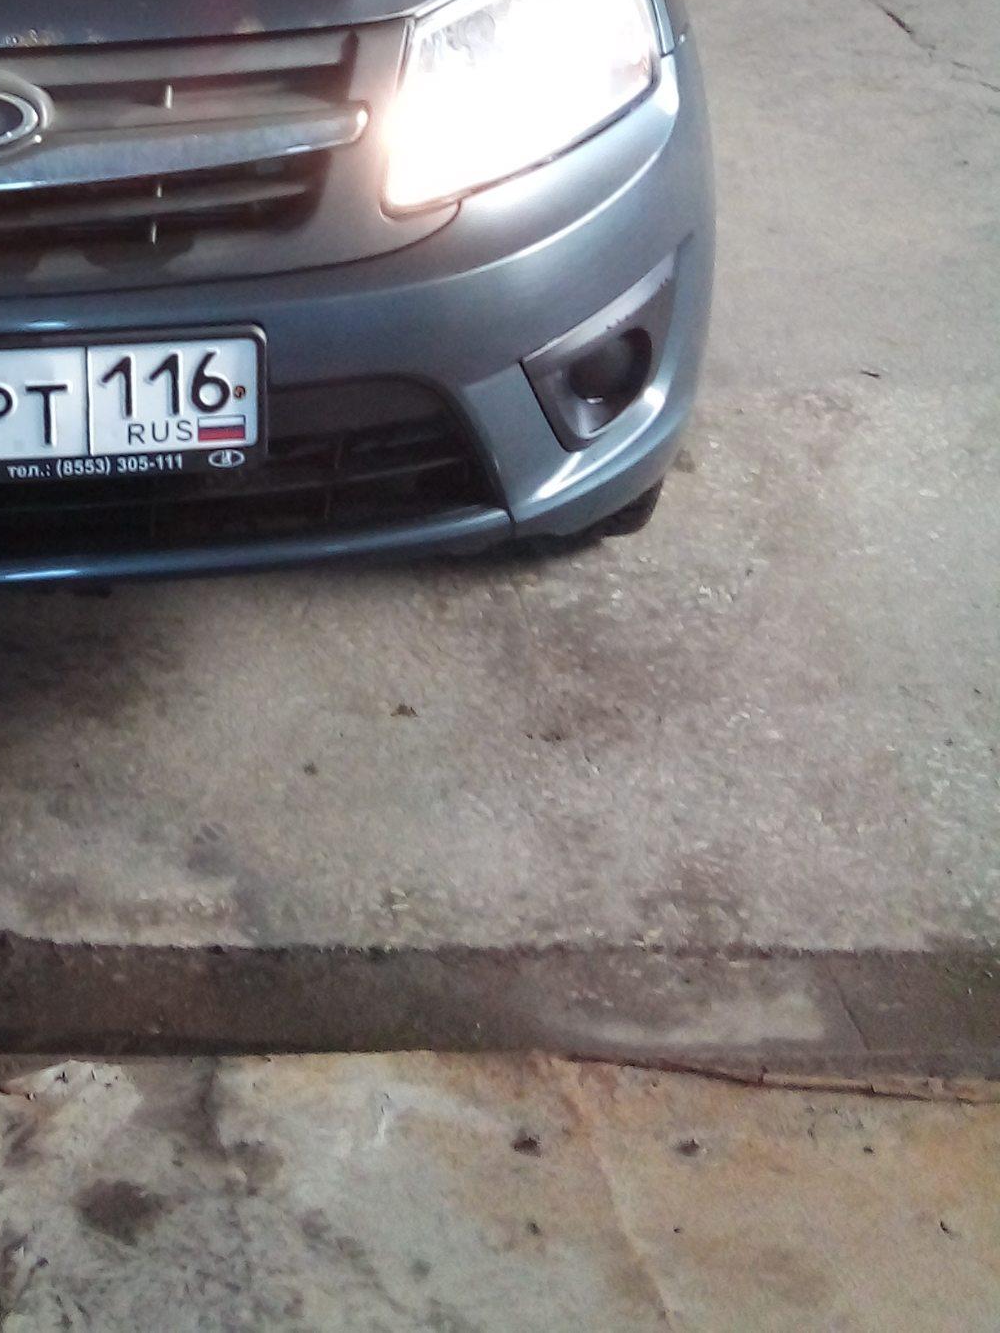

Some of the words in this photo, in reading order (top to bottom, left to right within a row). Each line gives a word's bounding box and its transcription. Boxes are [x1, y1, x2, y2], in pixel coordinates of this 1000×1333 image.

[102, 352, 231, 417] 116
[128, 420, 193, 445] RUS
[56, 457, 111, 478] (8553)
[116, 453, 184, 473] 305-111
